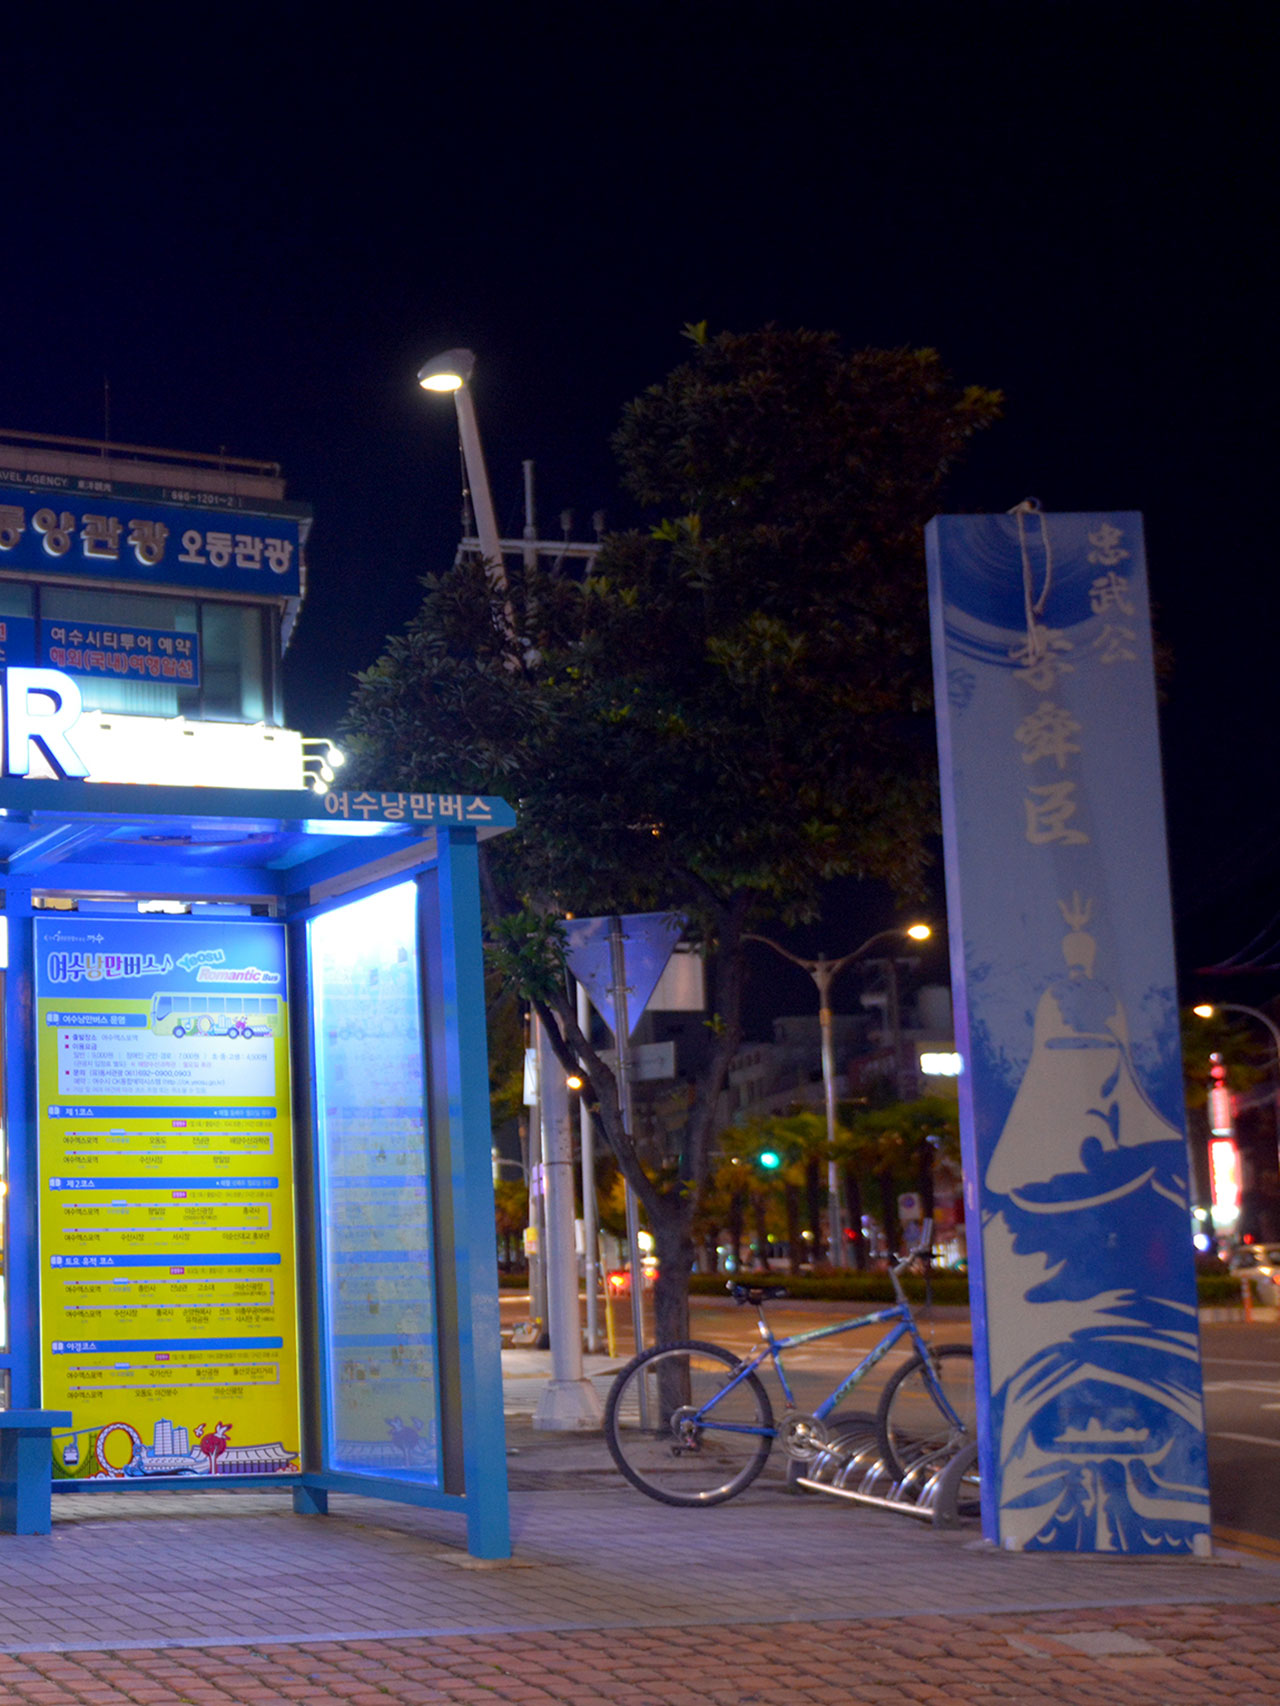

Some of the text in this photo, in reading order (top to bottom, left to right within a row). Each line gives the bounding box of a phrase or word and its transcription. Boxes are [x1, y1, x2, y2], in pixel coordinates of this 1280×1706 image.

[25, 474, 68, 487] AGENCY
[178, 529, 294, 574] 오동관광
[1087, 522, 1137, 666] 忠武公
[50, 627, 192, 656] 여수시티투어 예약
[1007, 625, 1090, 846] 李舜臣
[324, 791, 493, 822] 여수낭만버스
[48, 952, 161, 983] 여수낭만버스
[177, 949, 225, 972] Yeosu
[197, 967, 280, 983] Romantic Bus
[66, 1342, 97, 1353] 야경코스
